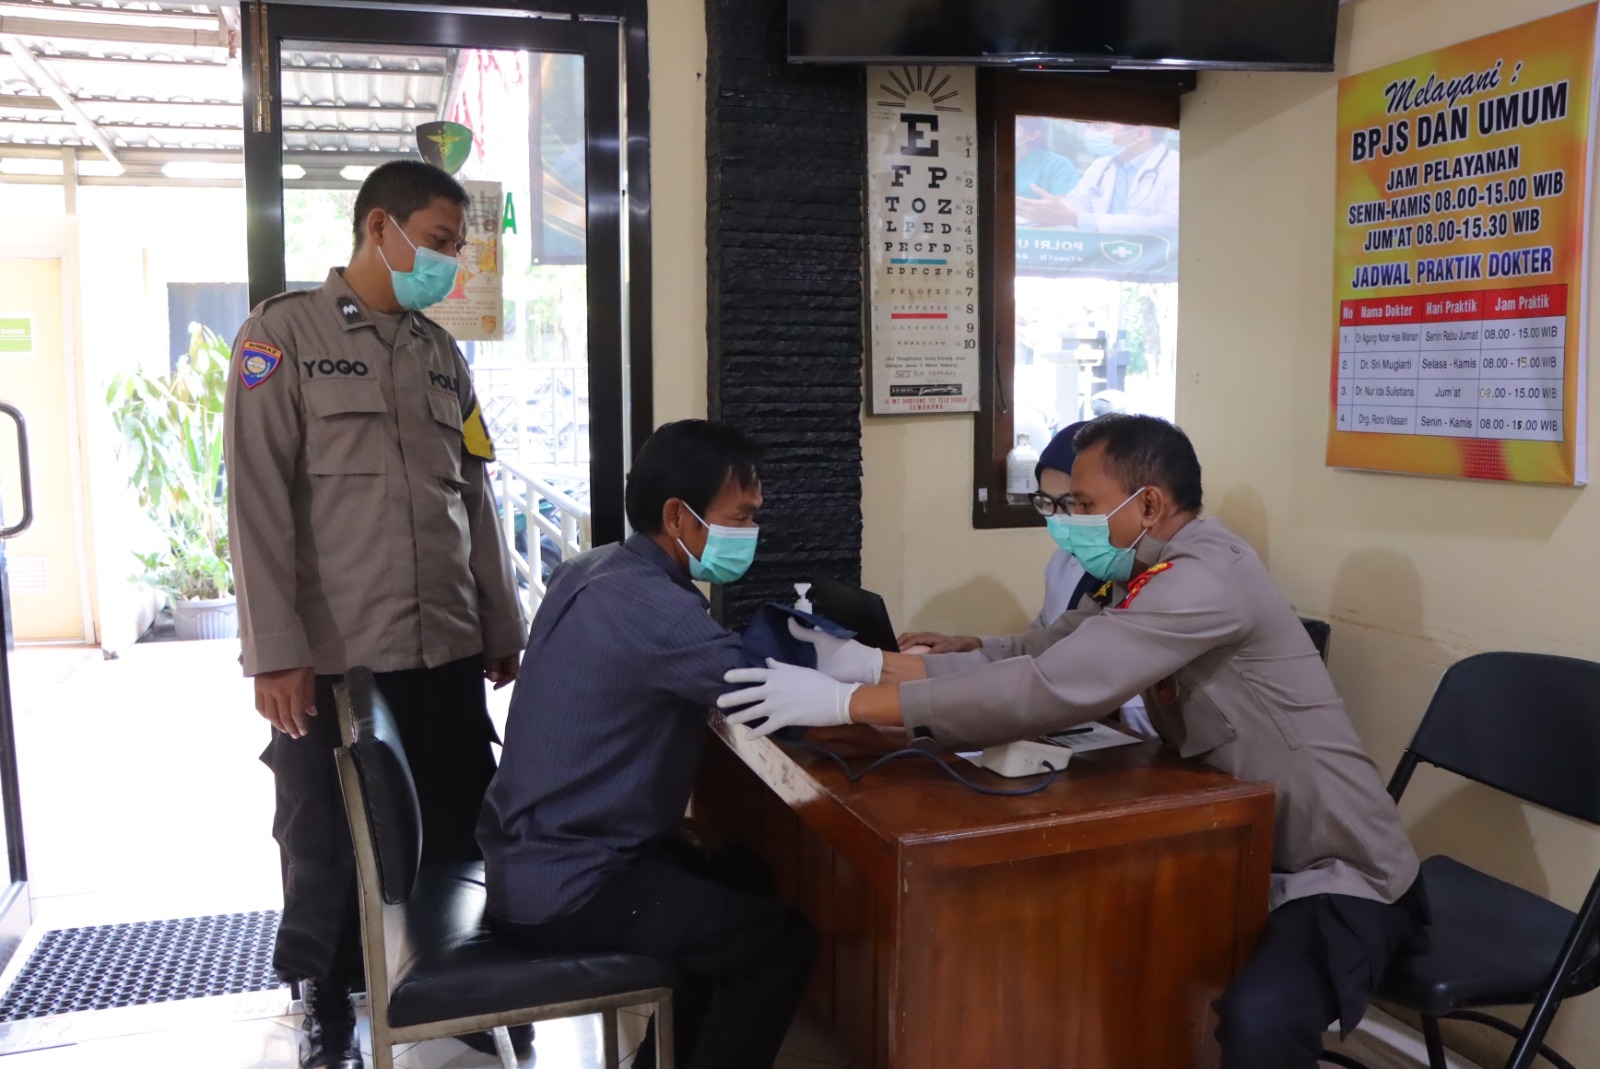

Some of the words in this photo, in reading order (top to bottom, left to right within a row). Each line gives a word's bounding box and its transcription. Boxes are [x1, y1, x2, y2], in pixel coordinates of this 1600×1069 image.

[1385, 60, 1501, 114] Melayani
[1352, 120, 1408, 161] BPJS
[1418, 107, 1467, 148] DAN
[1479, 82, 1568, 135] UMUM
[901, 113, 938, 157] E
[1387, 166, 1417, 190] JAM
[1424, 146, 1518, 184] PELAYANAN
[1349, 194, 1430, 224] SENIN-KAMIS
[1436, 178, 1526, 212] 08.00-15.00
[1534, 172, 1564, 197] WIB
[1365, 226, 1412, 251] JUM'AT
[1417, 214, 1506, 246] 08.00-15.30
[1512, 208, 1540, 232] WIB
[1352, 263, 1410, 288] JADWAL
[1417, 254, 1481, 284] PRAKTIK
[1488, 248, 1552, 277] DOKTER
[1426, 302, 1442, 314] Hari
[1446, 299, 1477, 314] Praktik
[1495, 298, 1516, 311] Jam
[1519, 294, 1550, 310] Praktik
[1343, 307, 1353, 319] No
[1361, 306, 1382, 318] Nama
[1386, 304, 1413, 317] Dokter
[1426, 331, 1442, 341] Senin
[1443, 330, 1457, 341] Rabu
[1459, 330, 1478, 341] Jumat
[1484, 329, 1510, 339] 08.00
[1519, 327, 1539, 338] 15.00
[1541, 326, 1558, 337] WIB
[249, 342, 276, 354] BINMAS
[963, 339, 976, 349] 10
[302, 358, 368, 378] YOGO
[1382, 359, 1411, 372] Mugiarti
[1422, 358, 1447, 369] Selasa
[1454, 358, 1476, 368] Kamis
[1483, 358, 1508, 368] 08.00
[1517, 356, 1540, 368] 15.00
[1542, 356, 1557, 367] WIB
[1515, 388, 1540, 398] 15.00
[1542, 388, 1557, 398] WIB
[1421, 416, 1442, 427] Senin
[1449, 417, 1472, 428] Kamis
[1480, 419, 1504, 429] 08.00
[1513, 420, 1537, 430] 15.00
[1540, 420, 1558, 431] WIB
